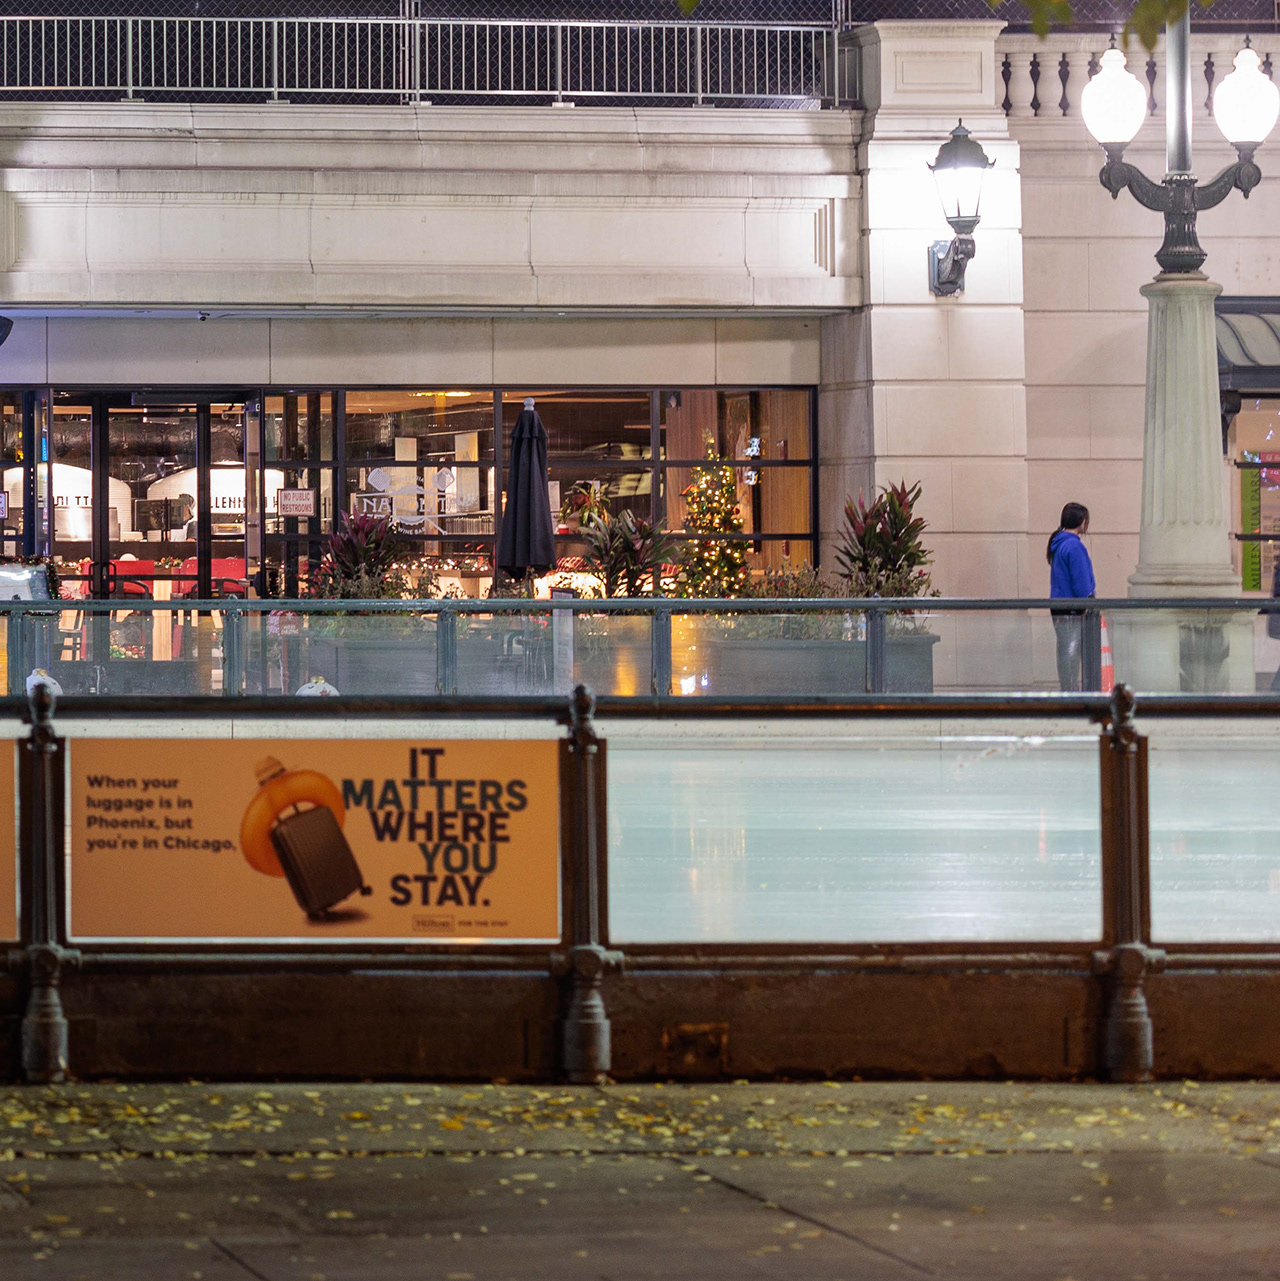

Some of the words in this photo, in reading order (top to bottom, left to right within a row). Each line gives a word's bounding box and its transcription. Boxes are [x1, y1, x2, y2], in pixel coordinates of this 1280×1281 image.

[283, 492, 291, 501] NO
[292, 492, 310, 501] PUBLIC
[282, 504, 312, 513] RESTROOMS
[410, 747, 444, 779] IT
[86, 775, 137, 788] When
[142, 777, 179, 792] your
[86, 796, 154, 812] luggage
[159, 796, 172, 808] is
[177, 796, 193, 808] in
[342, 779, 528, 811] MATTERS
[86, 815, 160, 830] Phoenix,
[164, 816, 193, 829] but
[369, 811, 510, 842] WHERE
[86, 834, 138, 852] you're
[143, 836, 158, 849] in
[163, 836, 237, 853] Chicago,
[418, 842, 497, 874] YOU
[389, 874, 491, 907] STAY.
